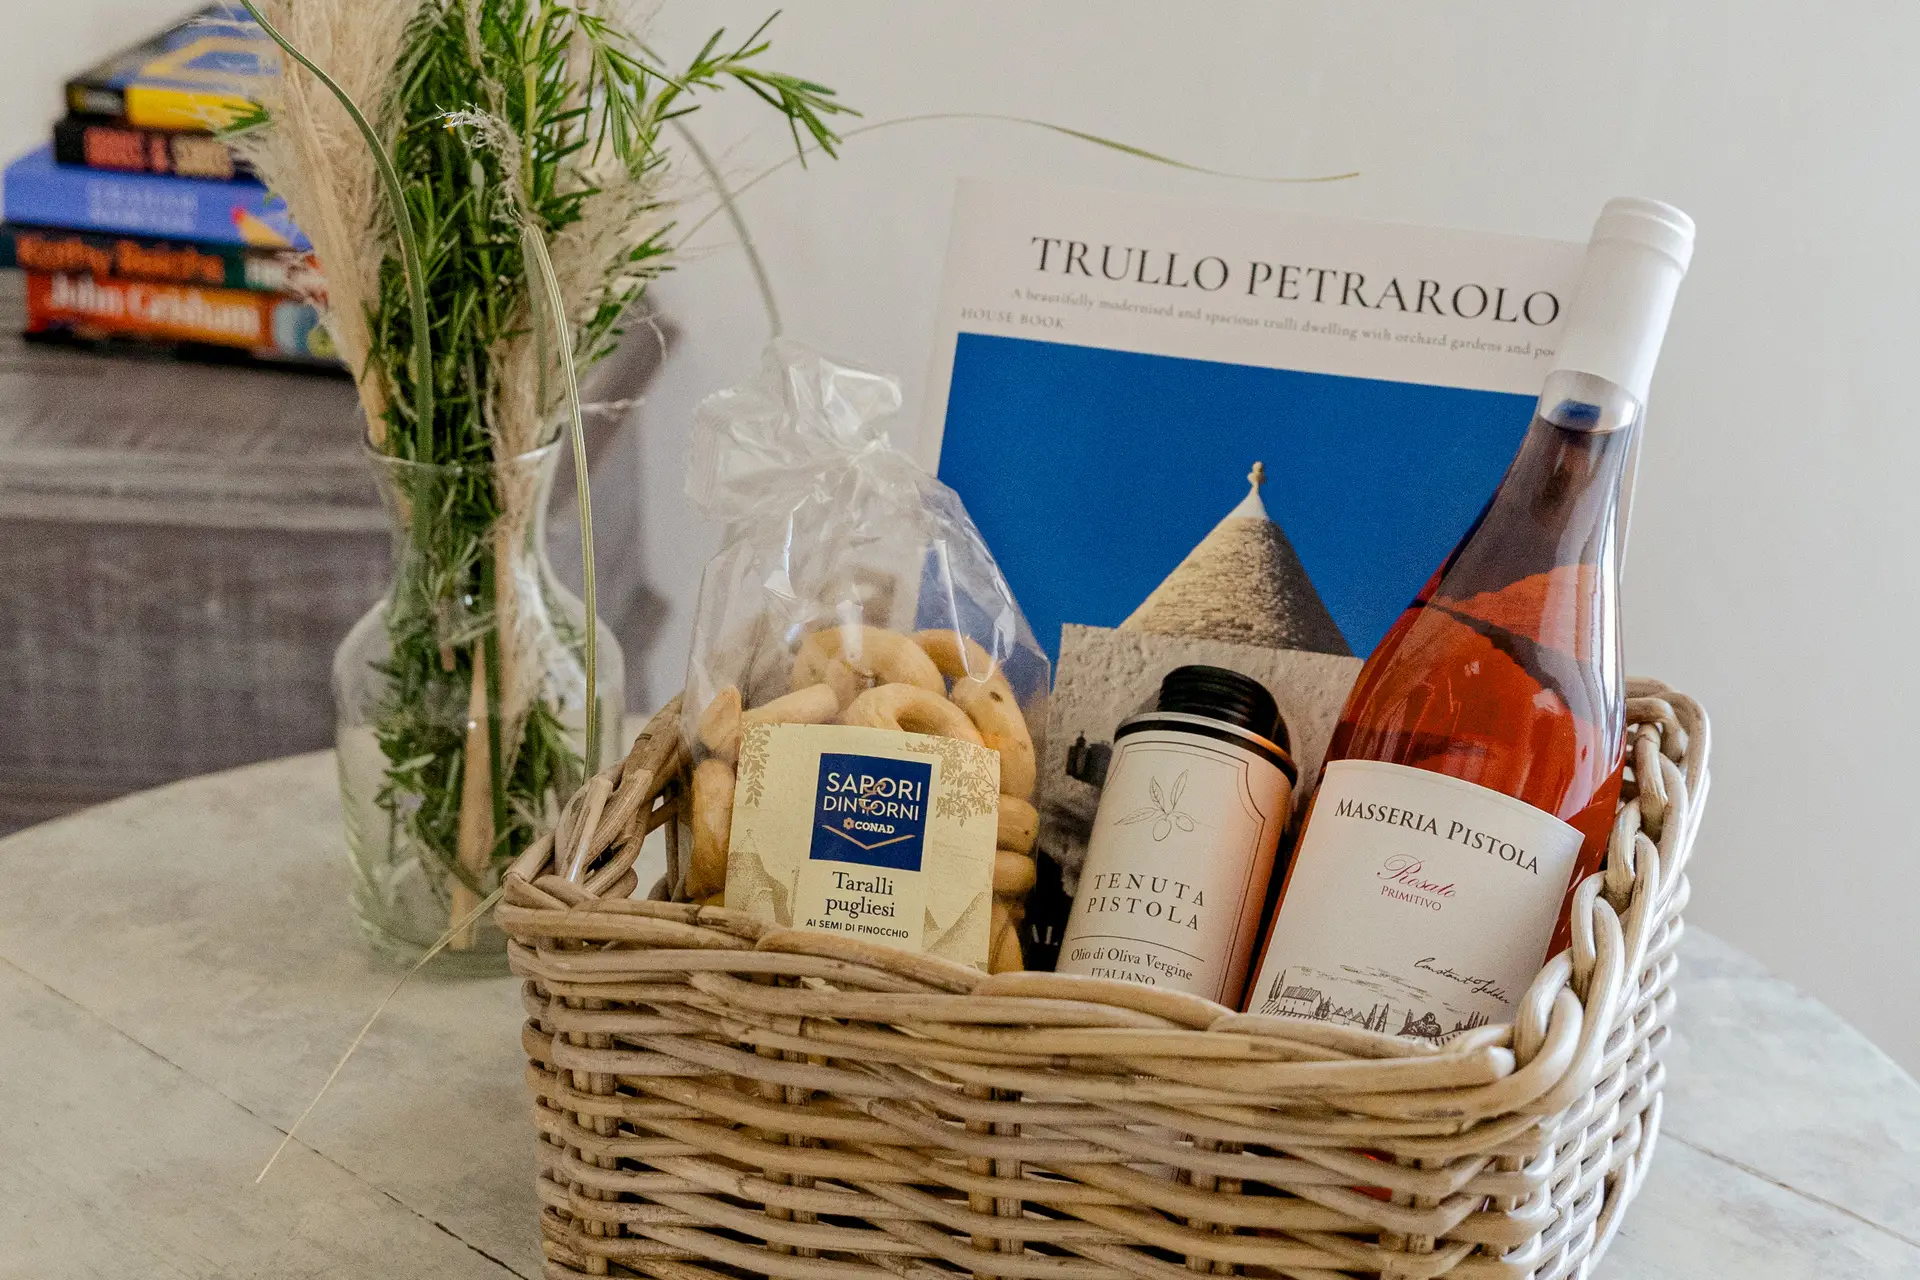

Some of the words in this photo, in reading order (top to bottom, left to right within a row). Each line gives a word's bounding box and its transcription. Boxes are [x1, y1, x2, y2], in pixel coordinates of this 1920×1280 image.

[1031, 236, 1229, 292] TRULLO
[1246, 261, 1560, 327] PETRAROLO
[961, 307, 1014, 324] HOUSE
[1020, 311, 1065, 329] BOOK
[1011, 287, 1022, 300] A
[1026, 288, 1095, 309] beautifully
[1099, 299, 1174, 318] modernised
[1178, 306, 1201, 321] and
[1205, 310, 1260, 328] spacious
[1263, 317, 1299, 331] trulli
[1301, 319, 1358, 341] dwelling
[1362, 326, 1392, 342] with
[1395, 330, 1448, 348] orchard
[1450, 335, 1502, 353] gardens
[1505, 341, 1531, 355] and
[825, 772, 922, 802] SAPORI
[823, 795, 920, 821] DINTORNI
[854, 821, 895, 834] CONAD
[1334, 798, 1440, 836] MASSERIA
[1446, 819, 1539, 876] PISTOLA
[832, 871, 894, 896] Taralli
[1376, 853, 1457, 899] Rosato
[1093, 873, 1205, 908] TENUTA
[1380, 885, 1443, 912] PRIMITIVO
[824, 895, 896, 919] pugliesi
[1087, 896, 1199, 931] PISTOLA
[805, 918, 817, 928] AI
[818, 919, 843, 931] SEMI
[845, 922, 856, 932] DI
[857, 923, 909, 939] FINOCCHIO
[1071, 948, 1091, 962] Olio
[1092, 947, 1104, 960] di
[1107, 948, 1141, 965] Oliva
[1145, 953, 1193, 981] Vergine
[1091, 967, 1156, 986] ITALIANO
